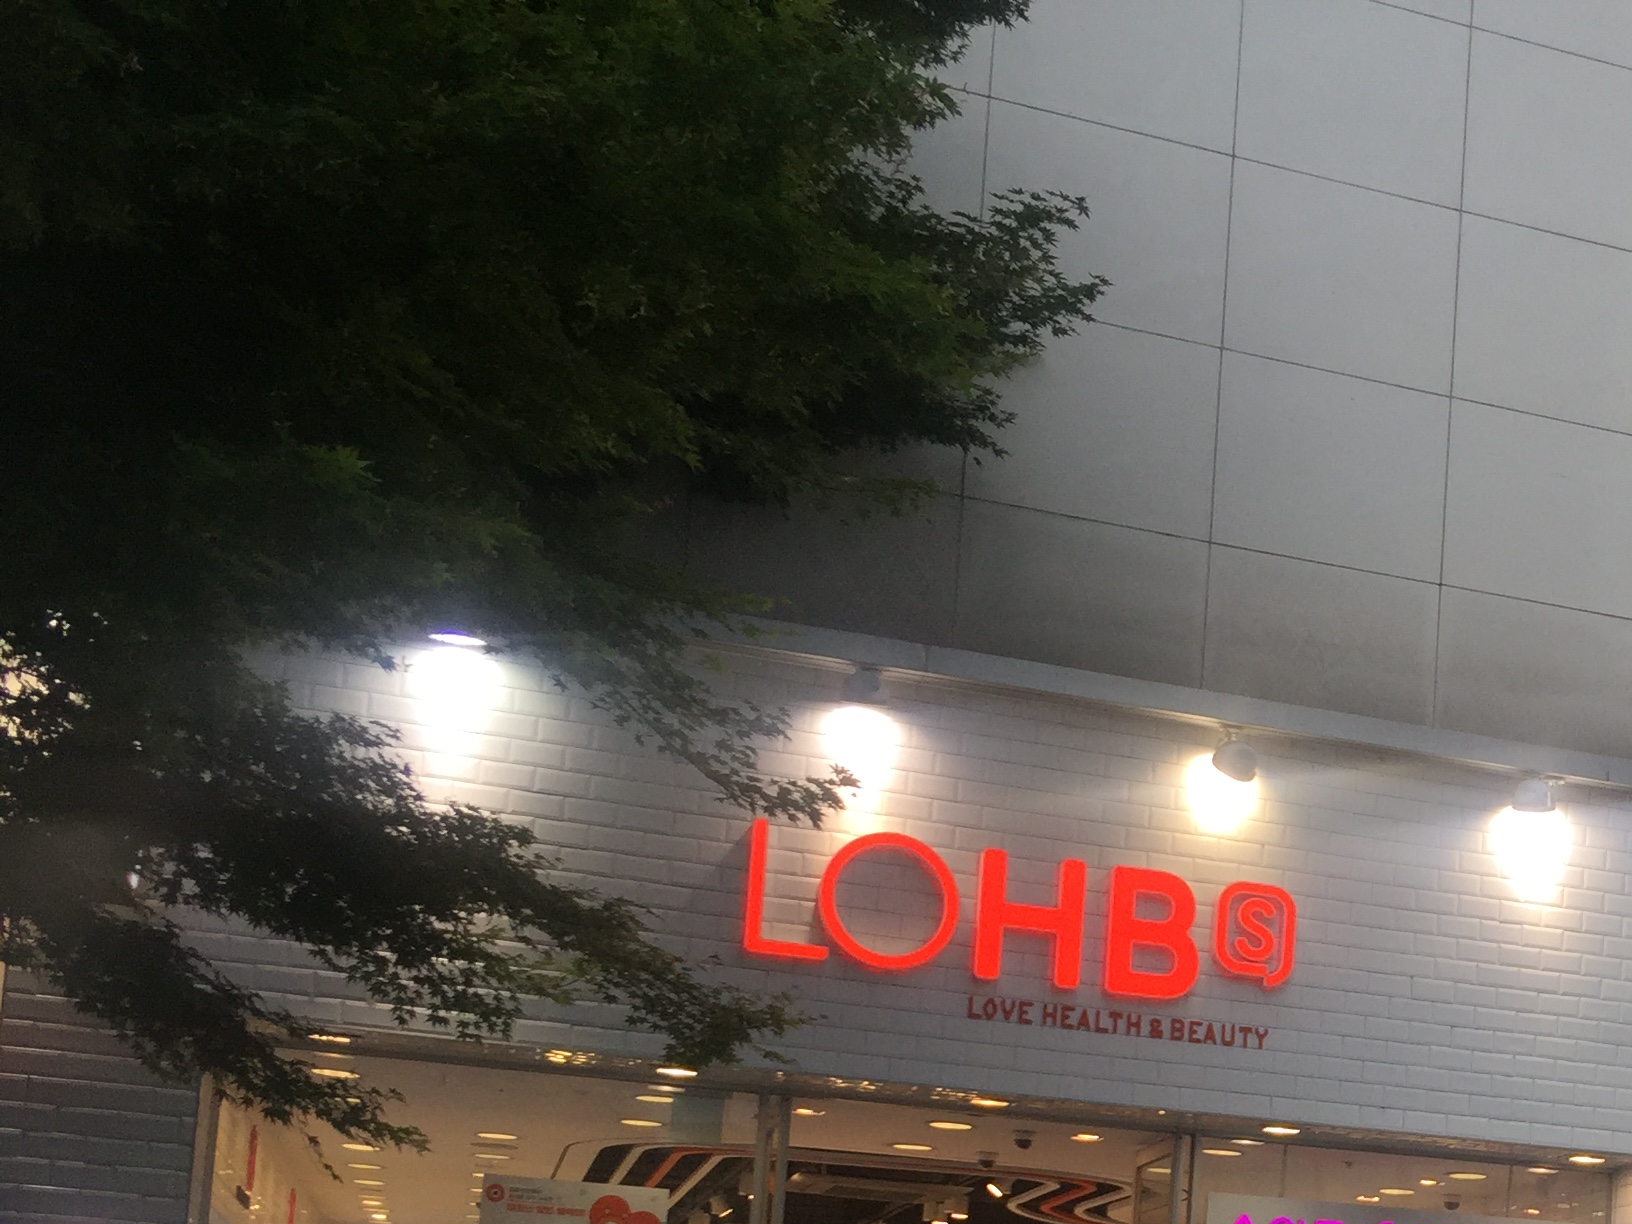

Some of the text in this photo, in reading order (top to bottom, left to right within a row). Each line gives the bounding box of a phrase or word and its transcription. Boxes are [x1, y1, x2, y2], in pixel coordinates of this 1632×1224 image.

[966, 995, 1270, 1050] LOVE HEALTH & BEAUTY
